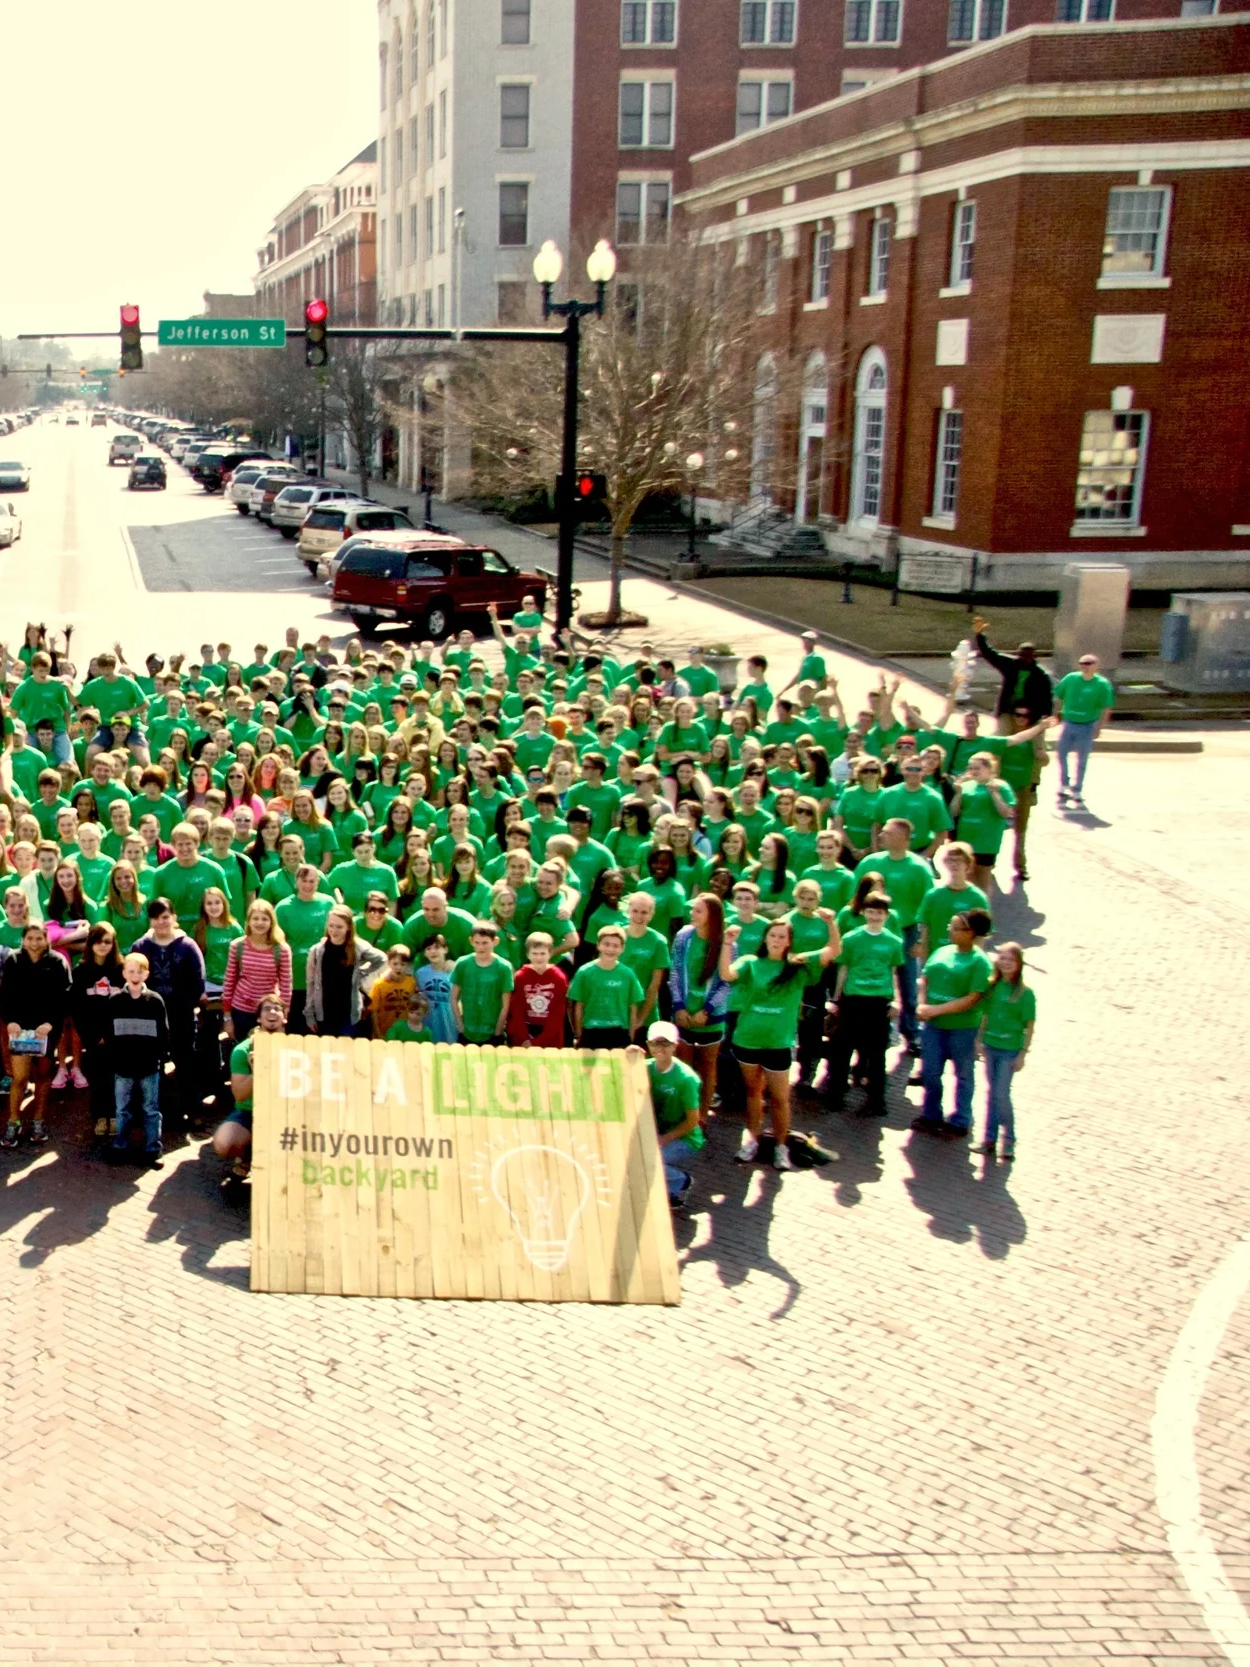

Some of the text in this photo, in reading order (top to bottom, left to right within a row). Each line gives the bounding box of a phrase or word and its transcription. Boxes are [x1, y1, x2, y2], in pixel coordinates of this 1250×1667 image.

[167, 325, 276, 340] Jefferson St
[279, 1048, 611, 1114] BE A LIGHT
[279, 1124, 454, 1159] #inyourown
[302, 1158, 439, 1193] backyard
